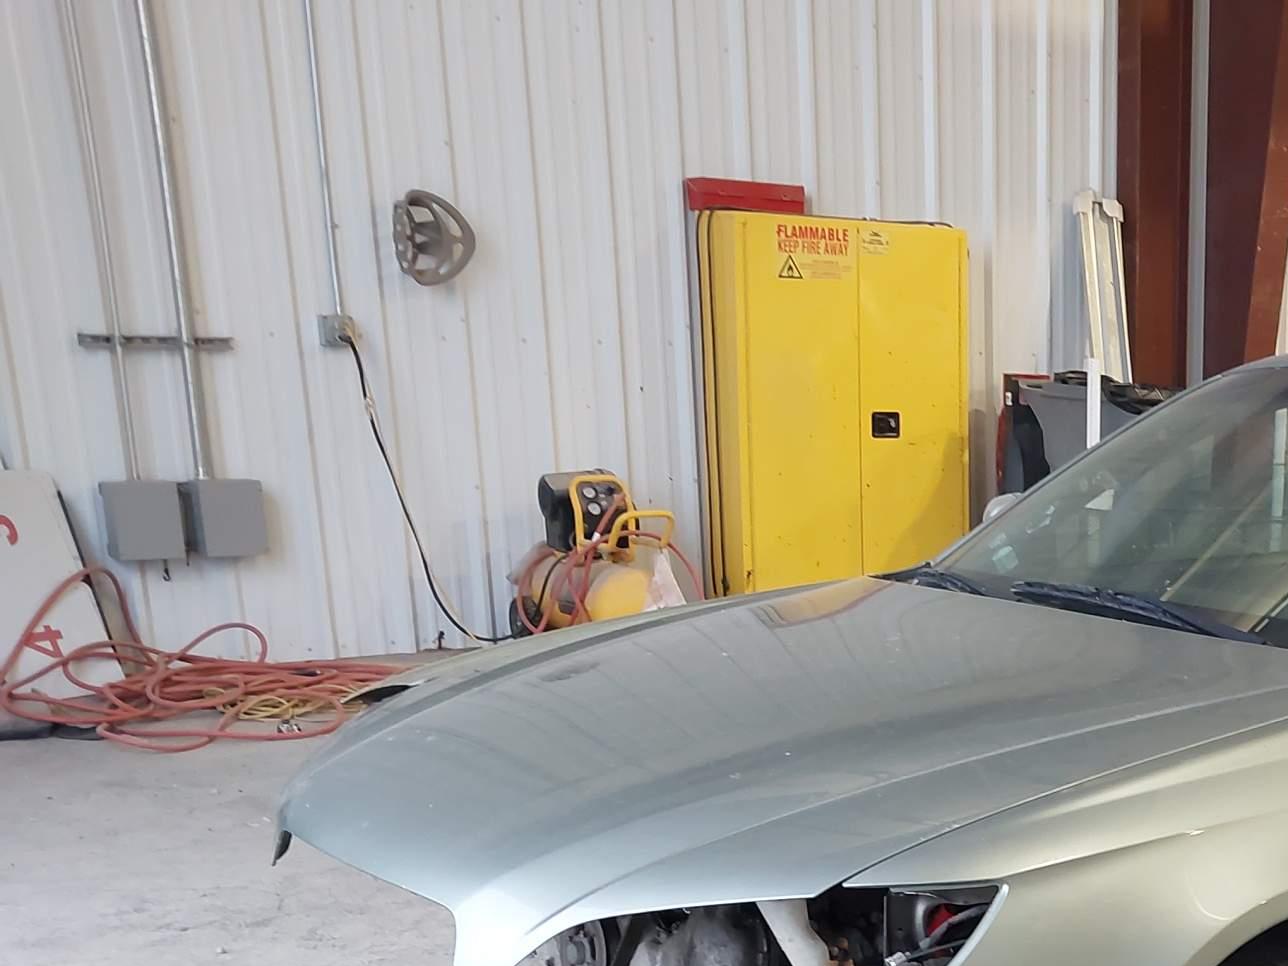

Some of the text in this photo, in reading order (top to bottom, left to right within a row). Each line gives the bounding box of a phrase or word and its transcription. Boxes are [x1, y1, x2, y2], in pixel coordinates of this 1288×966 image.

[776, 224, 849, 242] FLAMMABLE
[777, 240, 849, 256] KEEP FIRE AWAY
